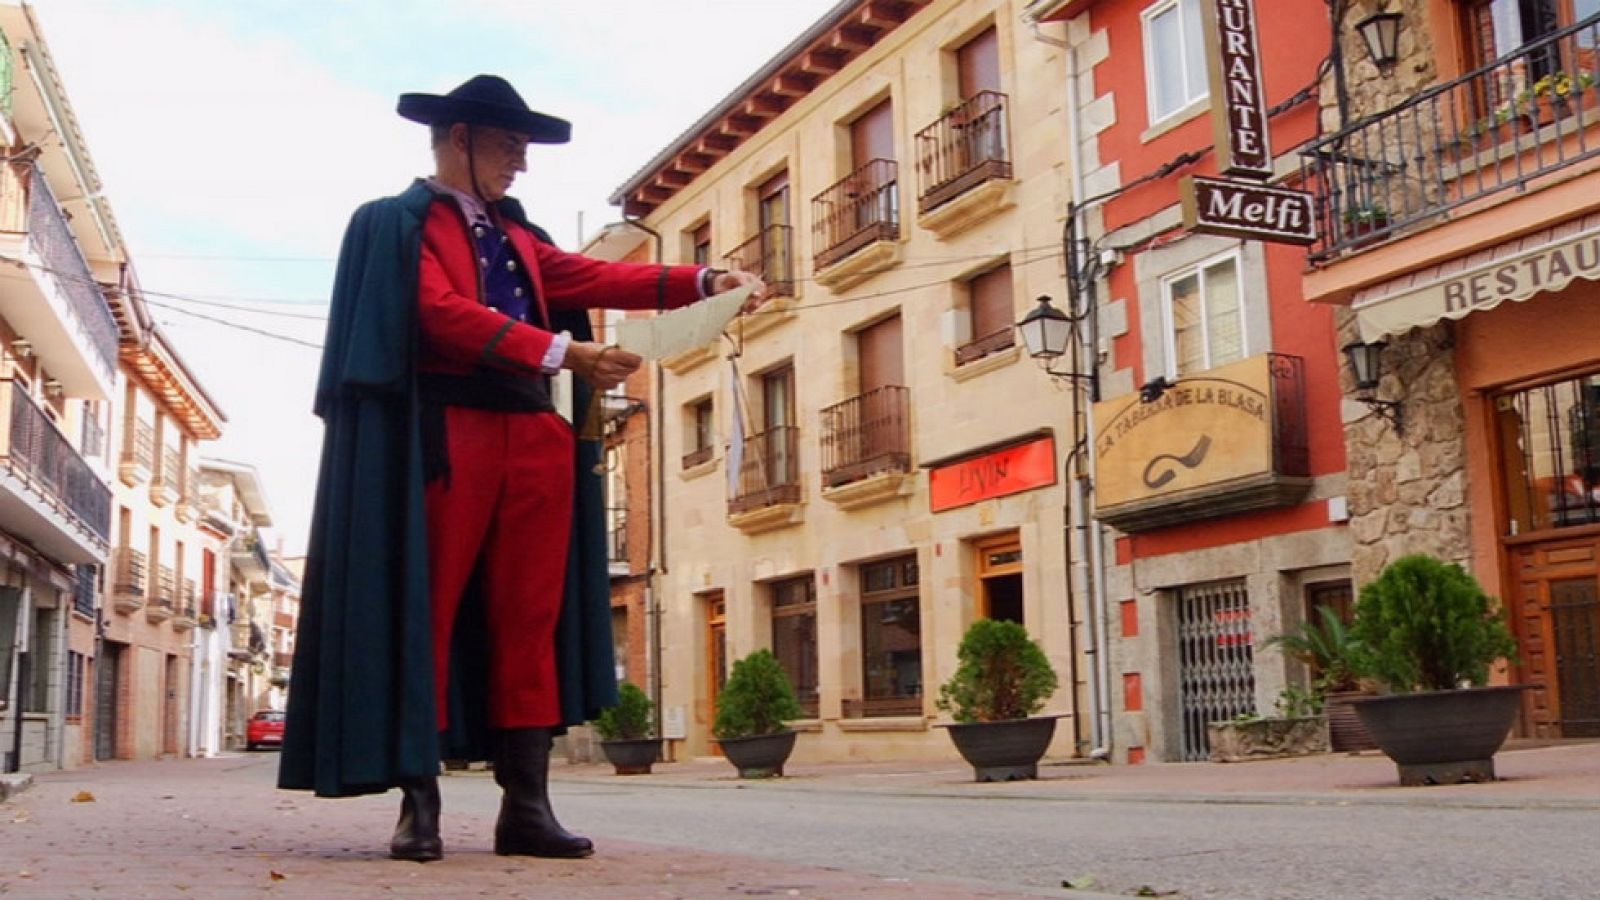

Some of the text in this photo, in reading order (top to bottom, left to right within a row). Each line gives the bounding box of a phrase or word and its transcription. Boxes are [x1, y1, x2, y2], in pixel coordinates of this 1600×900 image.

[1221, 0, 1259, 155] URANTE
[1207, 188, 1303, 230] Melfi
[1443, 238, 1600, 313] RESTAU
[1097, 434, 1115, 458] LA
[1174, 388, 1193, 407] DE
[1196, 387, 1214, 404] LA
[1217, 387, 1265, 421] BLASA
